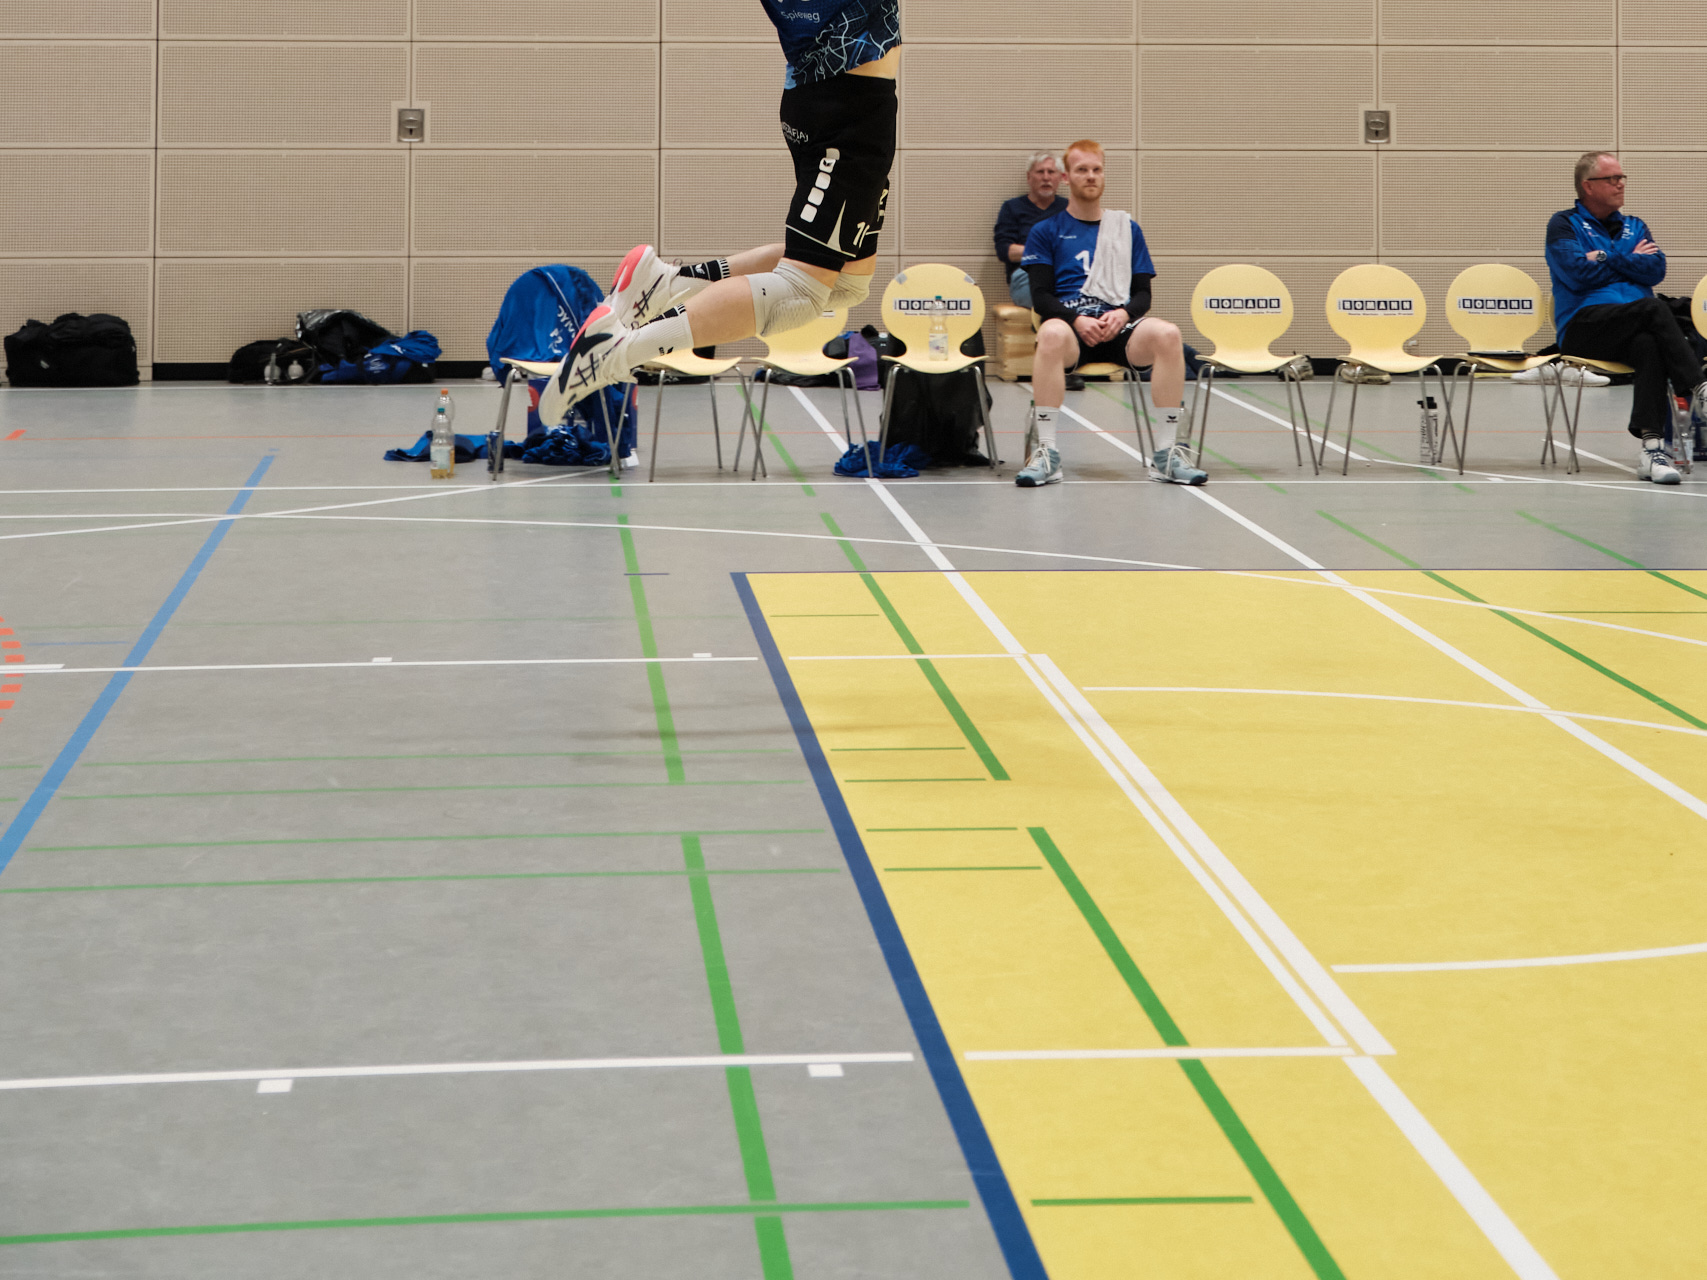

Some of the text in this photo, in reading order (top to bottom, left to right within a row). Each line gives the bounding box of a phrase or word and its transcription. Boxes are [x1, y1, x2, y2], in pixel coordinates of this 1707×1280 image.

[1209, 298, 1280, 309] HOMANN
[1342, 300, 1412, 310] HOMANN
[1462, 298, 1532, 309] HOMANN
